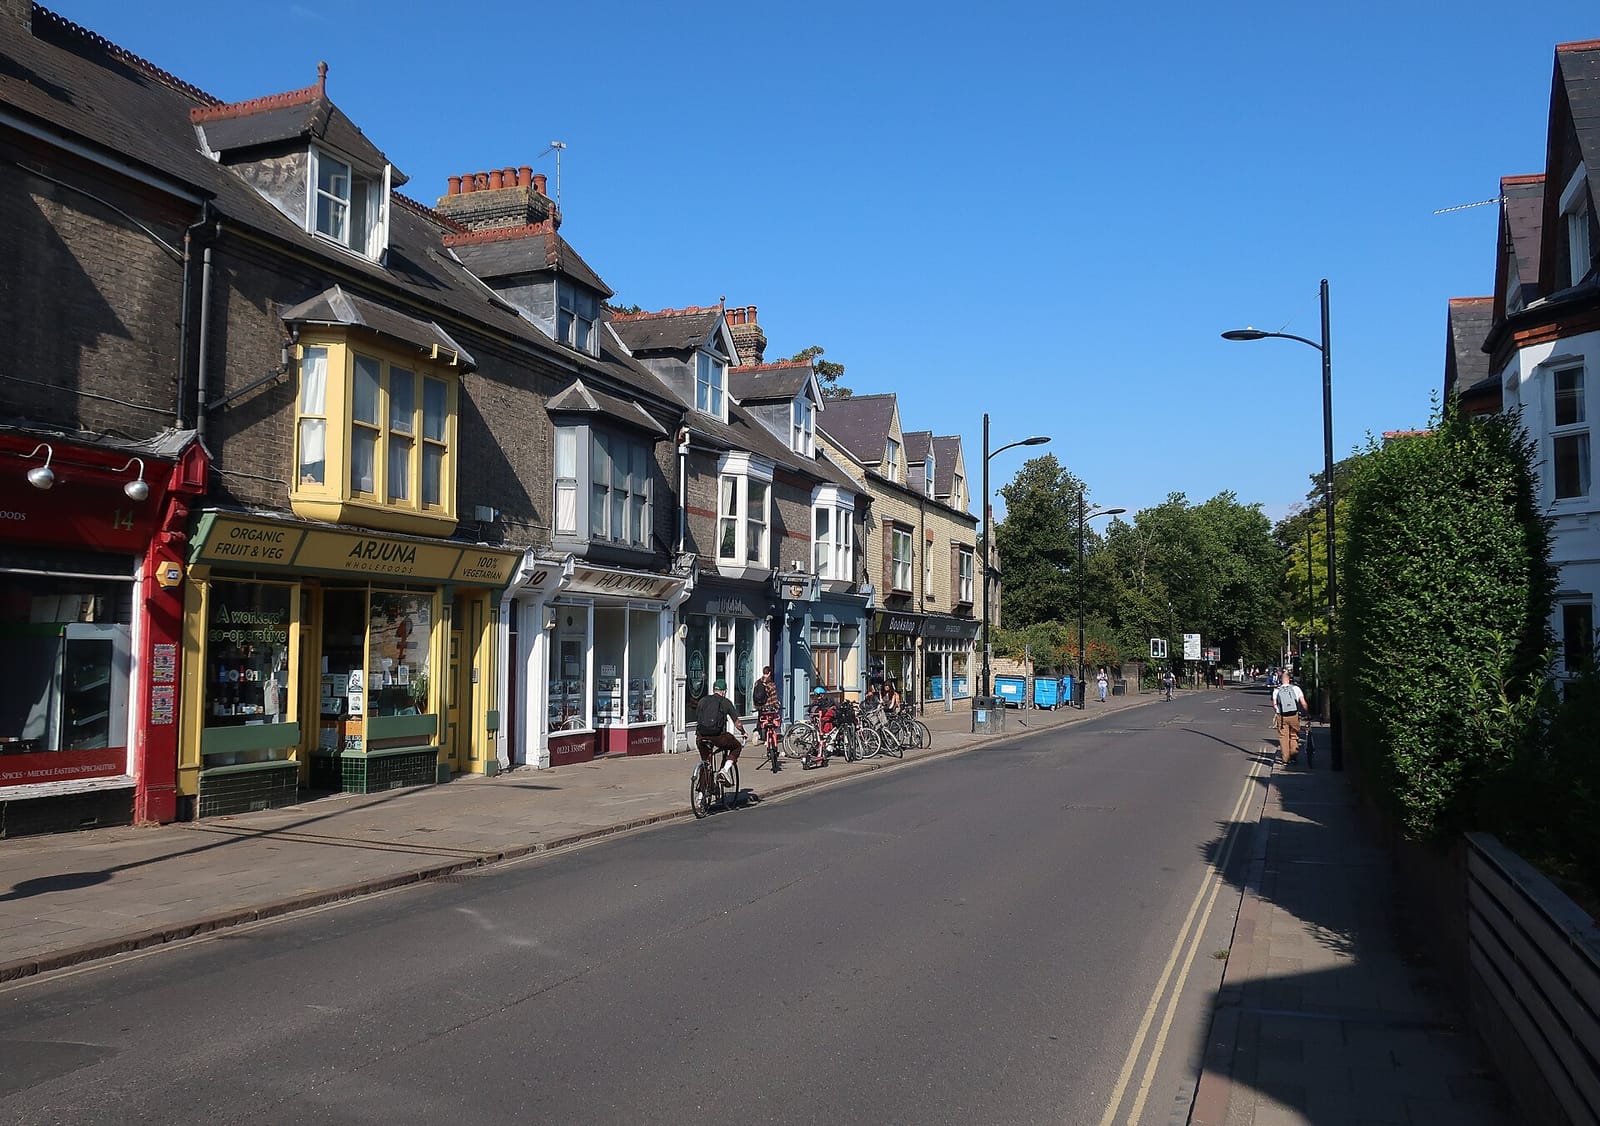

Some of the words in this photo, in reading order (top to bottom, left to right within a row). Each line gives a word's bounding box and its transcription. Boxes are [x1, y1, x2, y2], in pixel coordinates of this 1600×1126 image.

[112, 509, 134, 531] 14
[230, 527, 285, 543] ORGANIC
[214, 542, 250, 556] FRUIT
[250, 545, 259, 557] &
[262, 546, 284, 559] VEG
[348, 540, 417, 564] ARJUNA
[477, 556, 498, 569] 100%
[462, 568, 502, 580] VEGETARIAN
[526, 570, 548, 585] 10
[217, 603, 230, 623] A
[889, 617, 915, 634] Bookshop
[209, 625, 287, 648] co-operative
[2, 771, 23, 780] SPICES
[28, 768, 54, 777] MIDDLE
[54, 766, 80, 776] EASTERN
[80, 763, 116, 773] SPECIALITIES
